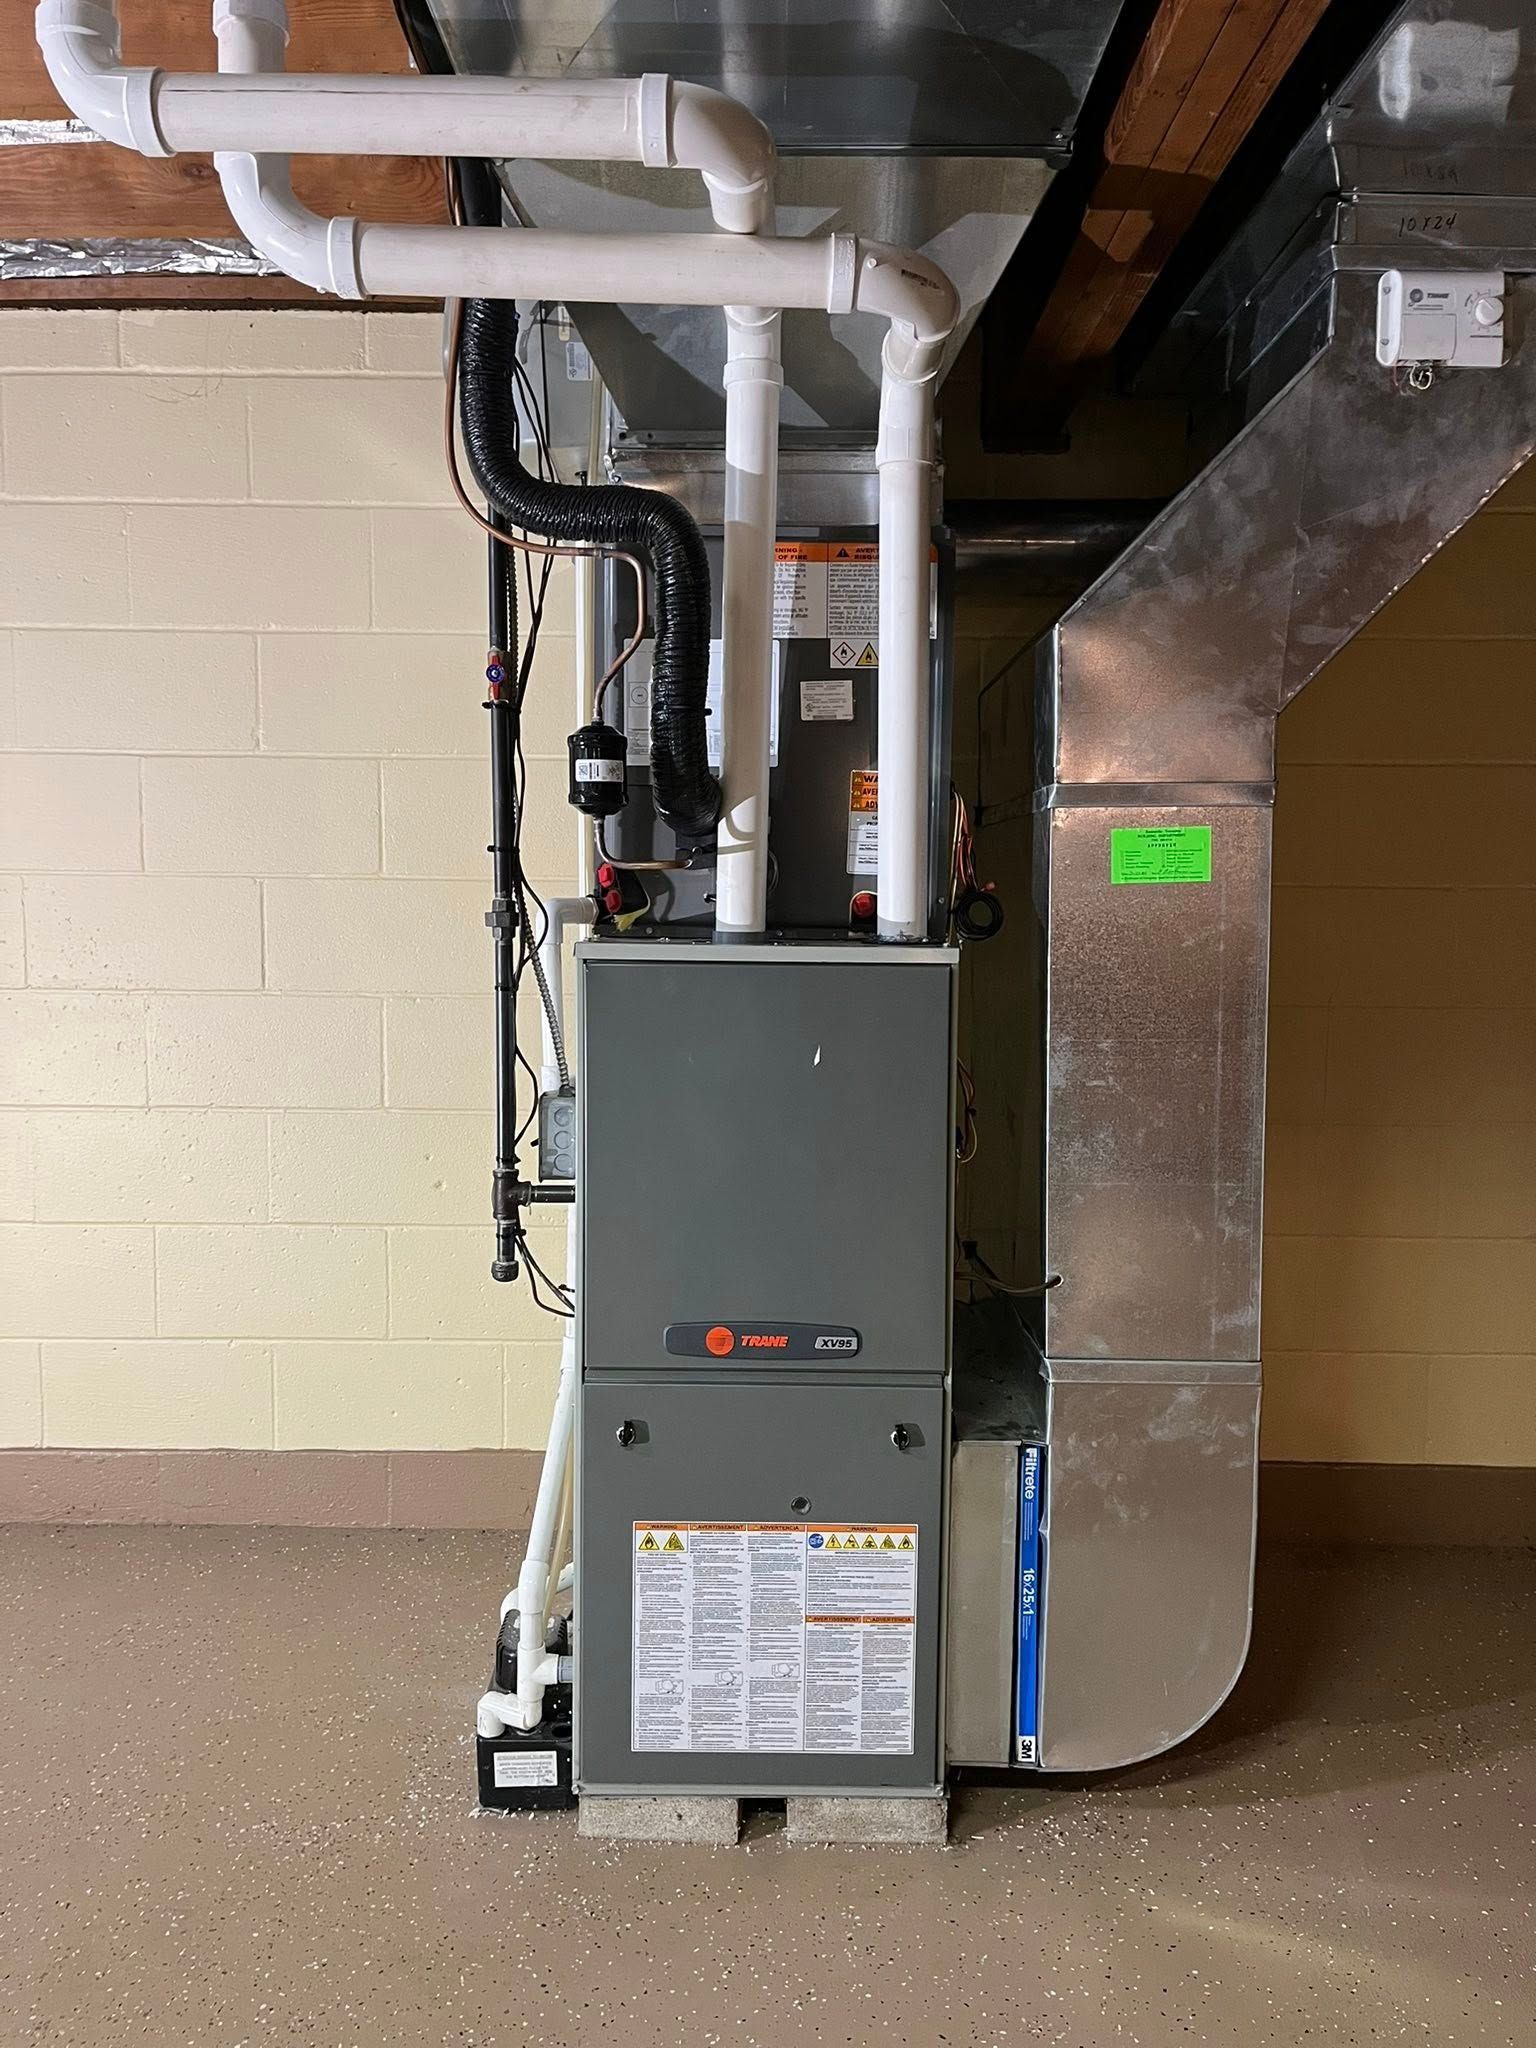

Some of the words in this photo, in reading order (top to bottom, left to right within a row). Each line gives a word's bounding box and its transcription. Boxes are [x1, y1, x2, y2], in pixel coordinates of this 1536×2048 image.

[741, 1335, 789, 1347] TRANE
[820, 1338, 853, 1348] XV95
[1024, 1447, 1038, 1500] Filtrete
[1022, 1567, 1035, 1616] 16x25x1
[1021, 1739, 1033, 1759] 3M
